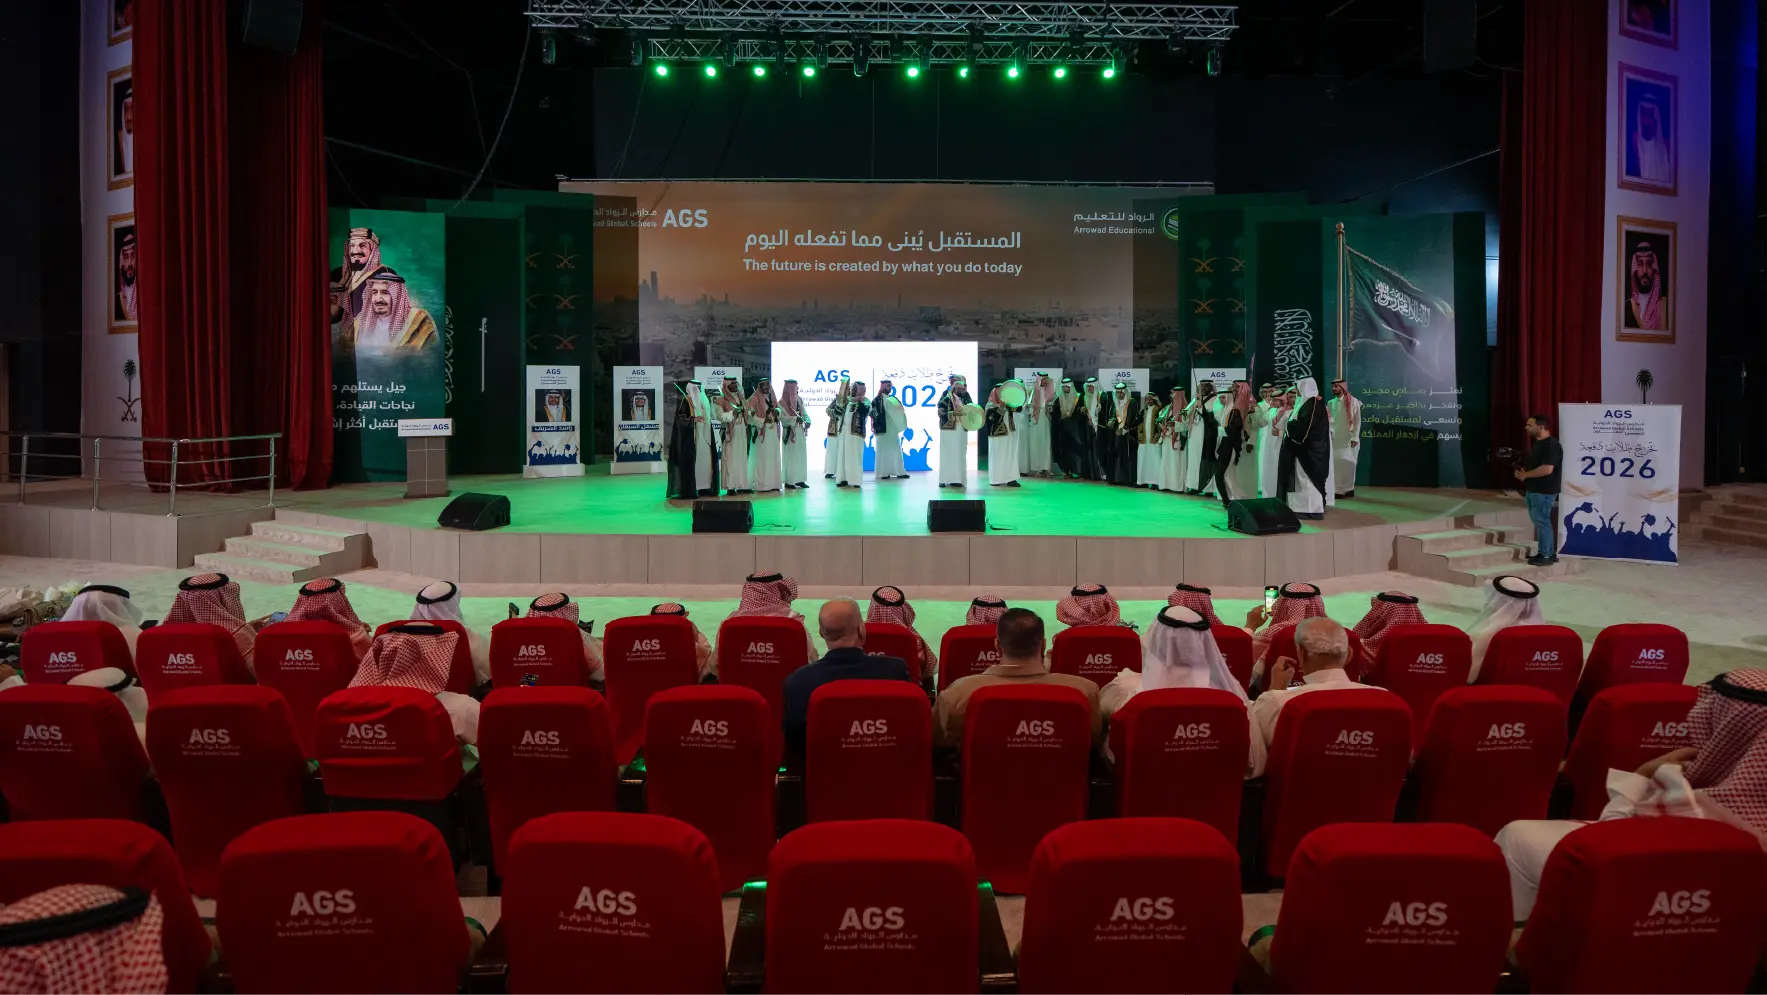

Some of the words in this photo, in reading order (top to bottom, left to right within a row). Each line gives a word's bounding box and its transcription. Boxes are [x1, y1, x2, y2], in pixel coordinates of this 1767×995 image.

[606, 219, 629, 228] Global
[630, 219, 658, 228] Schools
[661, 208, 709, 229] AGS
[1073, 212, 1125, 223] للتعليم
[1127, 212, 1155, 223] الرواد
[793, 229, 848, 247] تفعله
[851, 229, 883, 247] مما
[1073, 226, 1107, 235] Arrowad
[1108, 226, 1156, 235] Educational
[744, 229, 789, 253] اليوم
[928, 230, 1021, 252] المستقبل
[743, 259, 769, 271] The
[771, 259, 812, 271] future
[814, 260, 826, 271] is
[829, 260, 880, 272] created
[882, 260, 899, 275] by
[902, 261, 934, 273] what
[937, 263, 962, 276] you
[965, 261, 982, 273] do
[984, 262, 1023, 277] today
[813, 369, 850, 383] AGS
[341, 381, 383, 394] يستلهم
[386, 381, 407, 394] جيل
[380, 400, 415, 412] نجاحات
[1603, 409, 1633, 419] AGS
[432, 423, 450, 431] AGS
[1580, 455, 1656, 479] 2026
[519, 645, 546, 658] AGS
[632, 639, 660, 652] AGS
[746, 642, 775, 655] AGS
[1639, 648, 1665, 660] AGS
[49, 652, 78, 665] AGS
[168, 653, 196, 666] AGS
[285, 649, 314, 662] AGS
[1085, 653, 1113, 666] AGS
[1416, 653, 1444, 665] AGS
[1532, 651, 1560, 662] AGS
[23, 724, 62, 741] AGS
[346, 722, 388, 740] AGS
[690, 718, 729, 737] AGS
[849, 718, 889, 736] AGS
[1015, 719, 1056, 737] AGS
[1173, 722, 1212, 740] AGS
[1487, 722, 1526, 740] AGS
[1650, 720, 1688, 738] AGS
[189, 728, 232, 745] AGS
[520, 729, 561, 746] AGS
[1335, 729, 1375, 746] AGS
[290, 888, 357, 917] AGS
[574, 885, 638, 916] AGS
[1110, 896, 1175, 922] AGS
[1648, 888, 1713, 917] AGS
[838, 905, 906, 931] AGS
[1381, 900, 1449, 926] AGS
